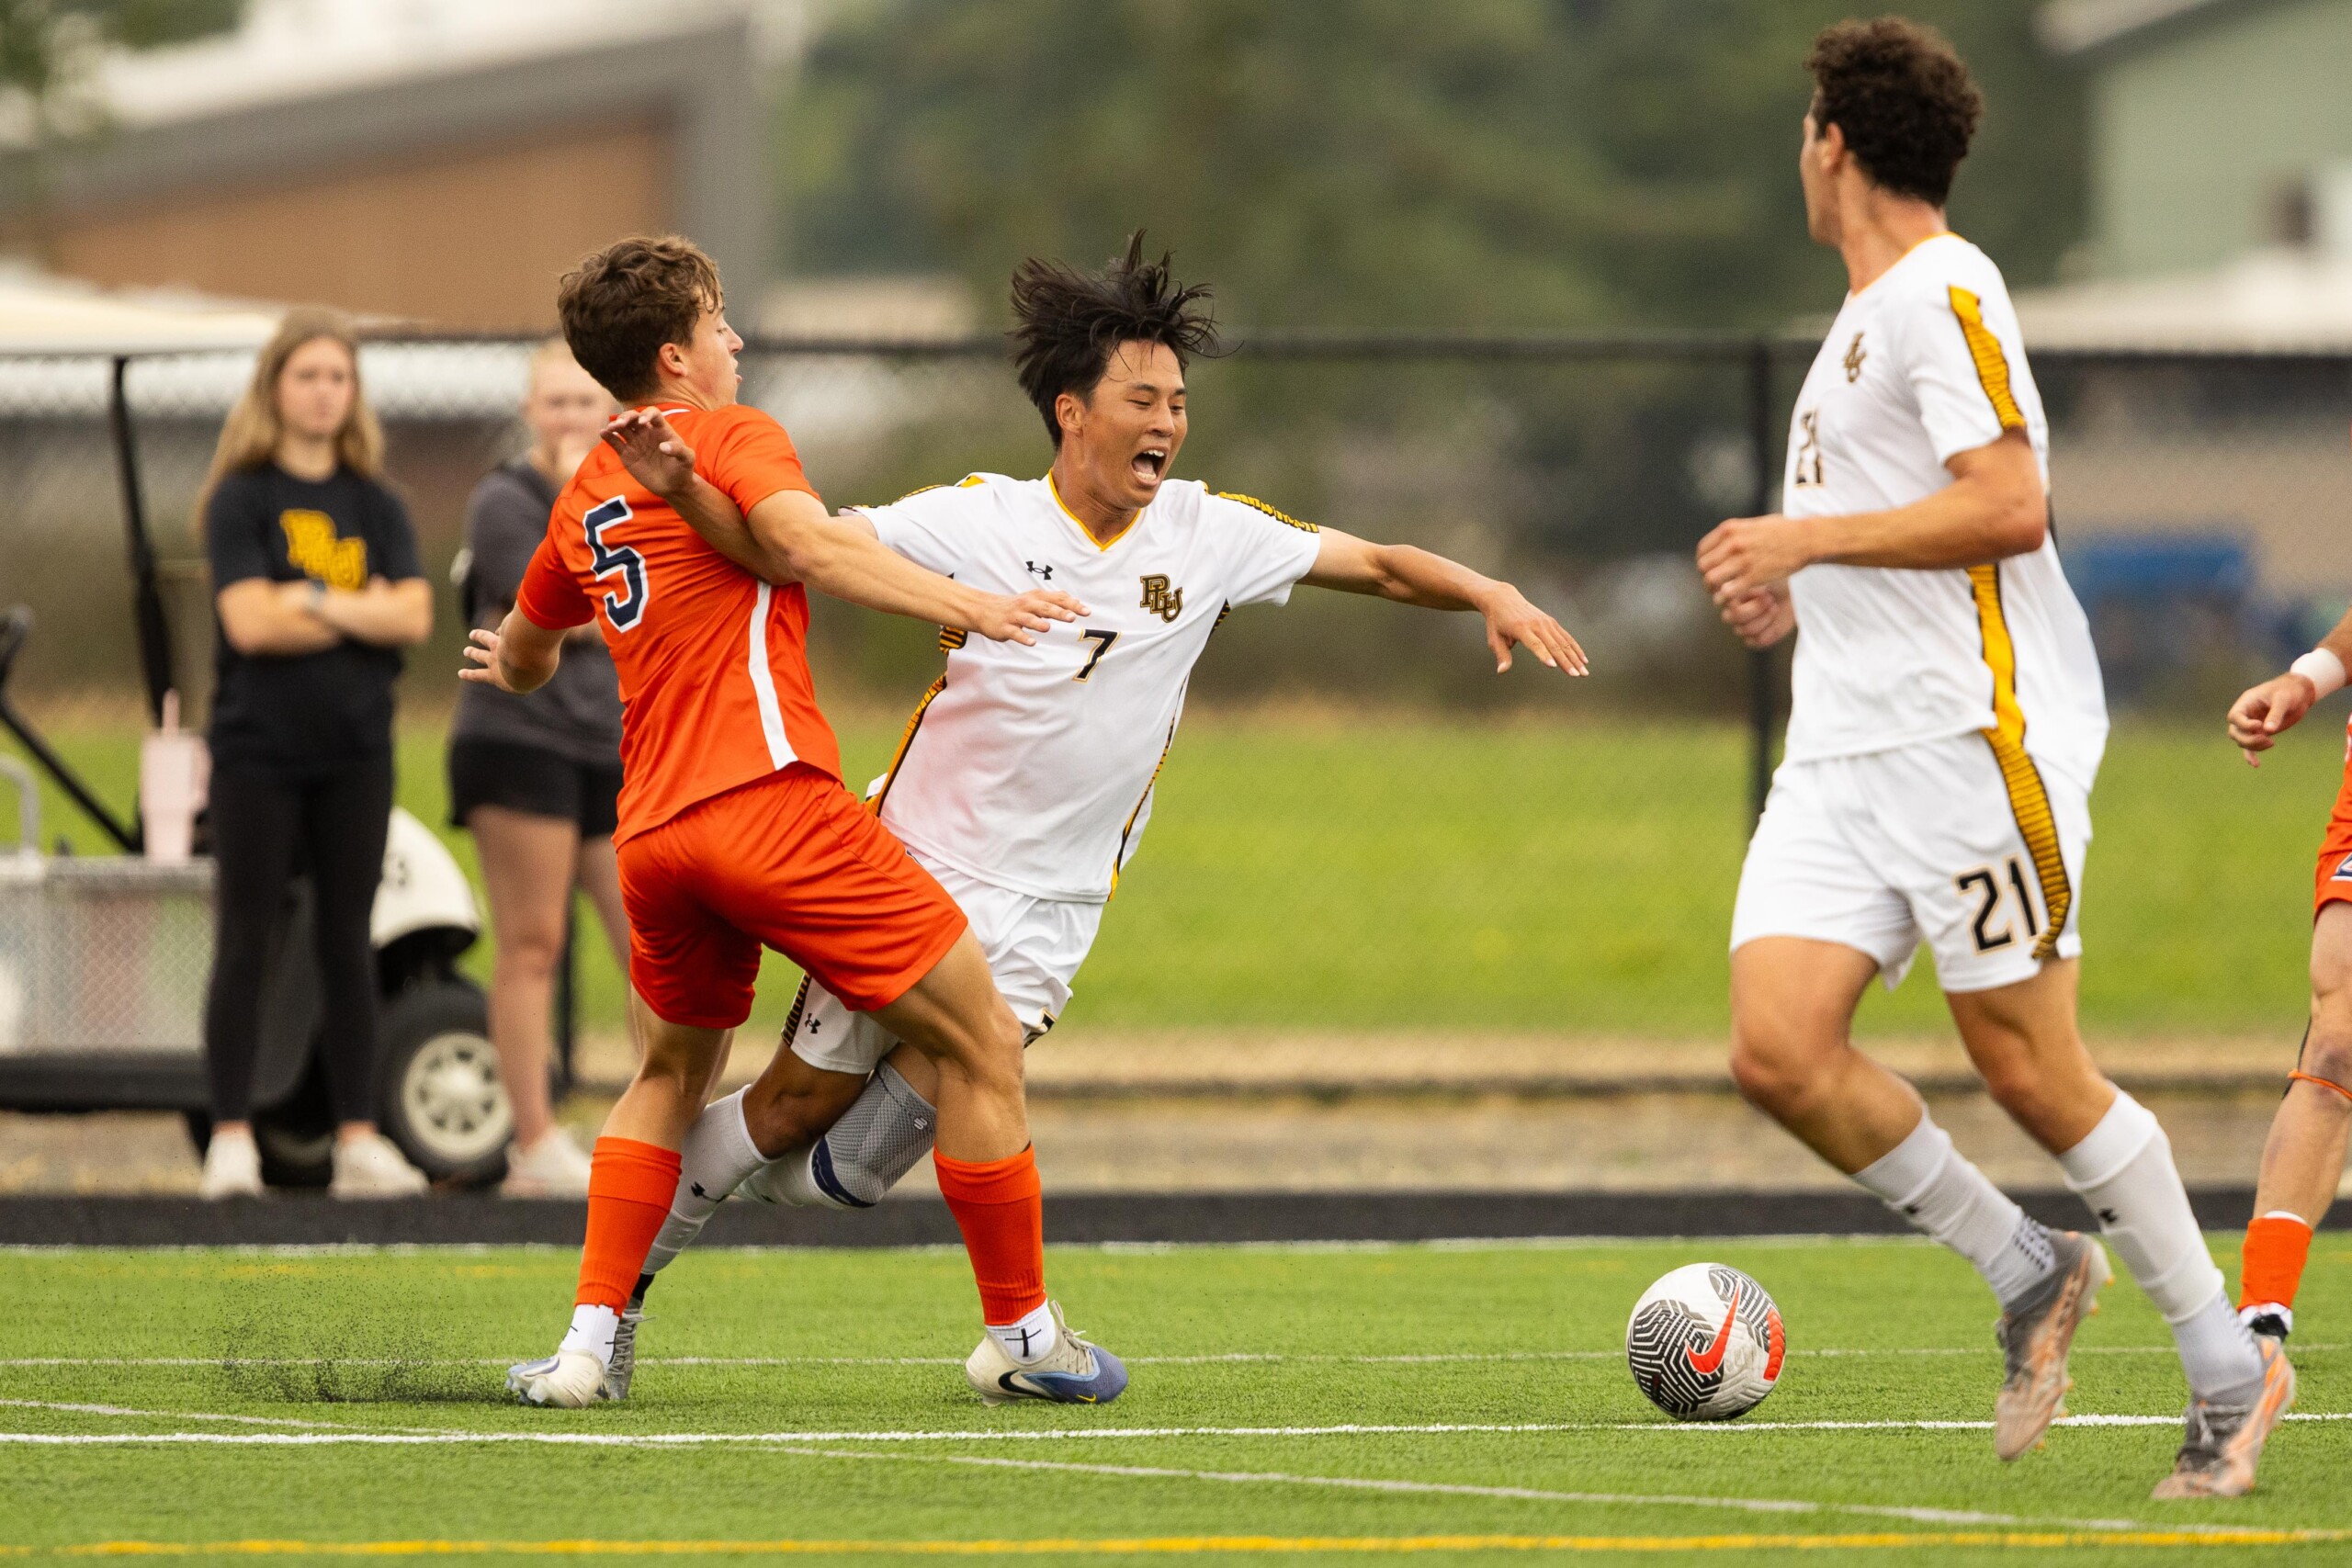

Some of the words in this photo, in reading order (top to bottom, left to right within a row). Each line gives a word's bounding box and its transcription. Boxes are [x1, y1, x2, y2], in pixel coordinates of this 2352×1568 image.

[583, 494, 649, 633] 5
[1139, 573, 1183, 623] PLU
[1072, 628, 1121, 682] 7
[1953, 854, 2041, 956] 21
